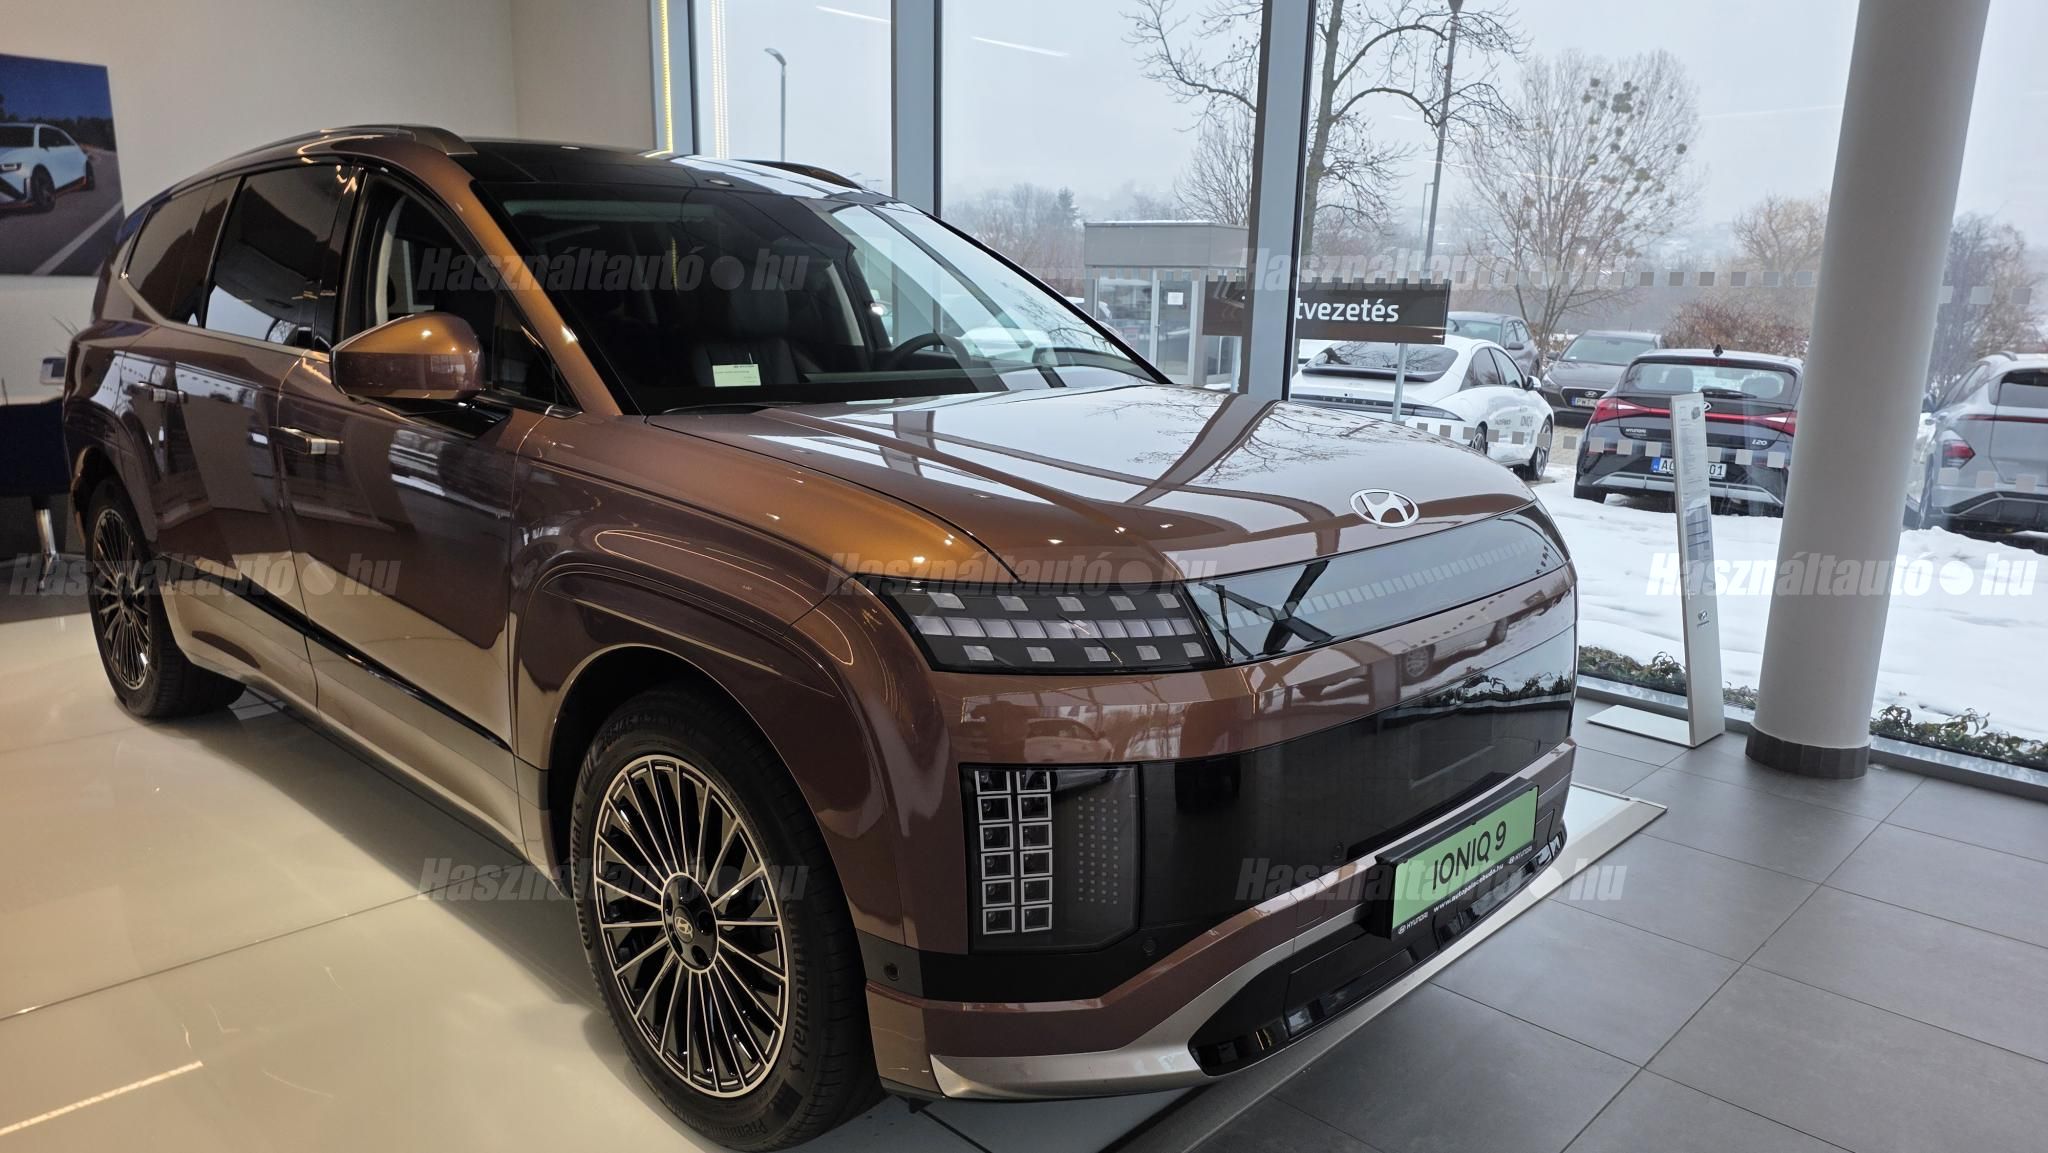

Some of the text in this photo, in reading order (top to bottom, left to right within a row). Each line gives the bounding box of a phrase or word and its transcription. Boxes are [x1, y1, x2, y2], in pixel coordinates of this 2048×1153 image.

[1295, 298, 1399, 323] tvezetés
[1432, 821, 1507, 890] IONIQ 9
[1433, 864, 1504, 912] www.autopalacebuda.hu
